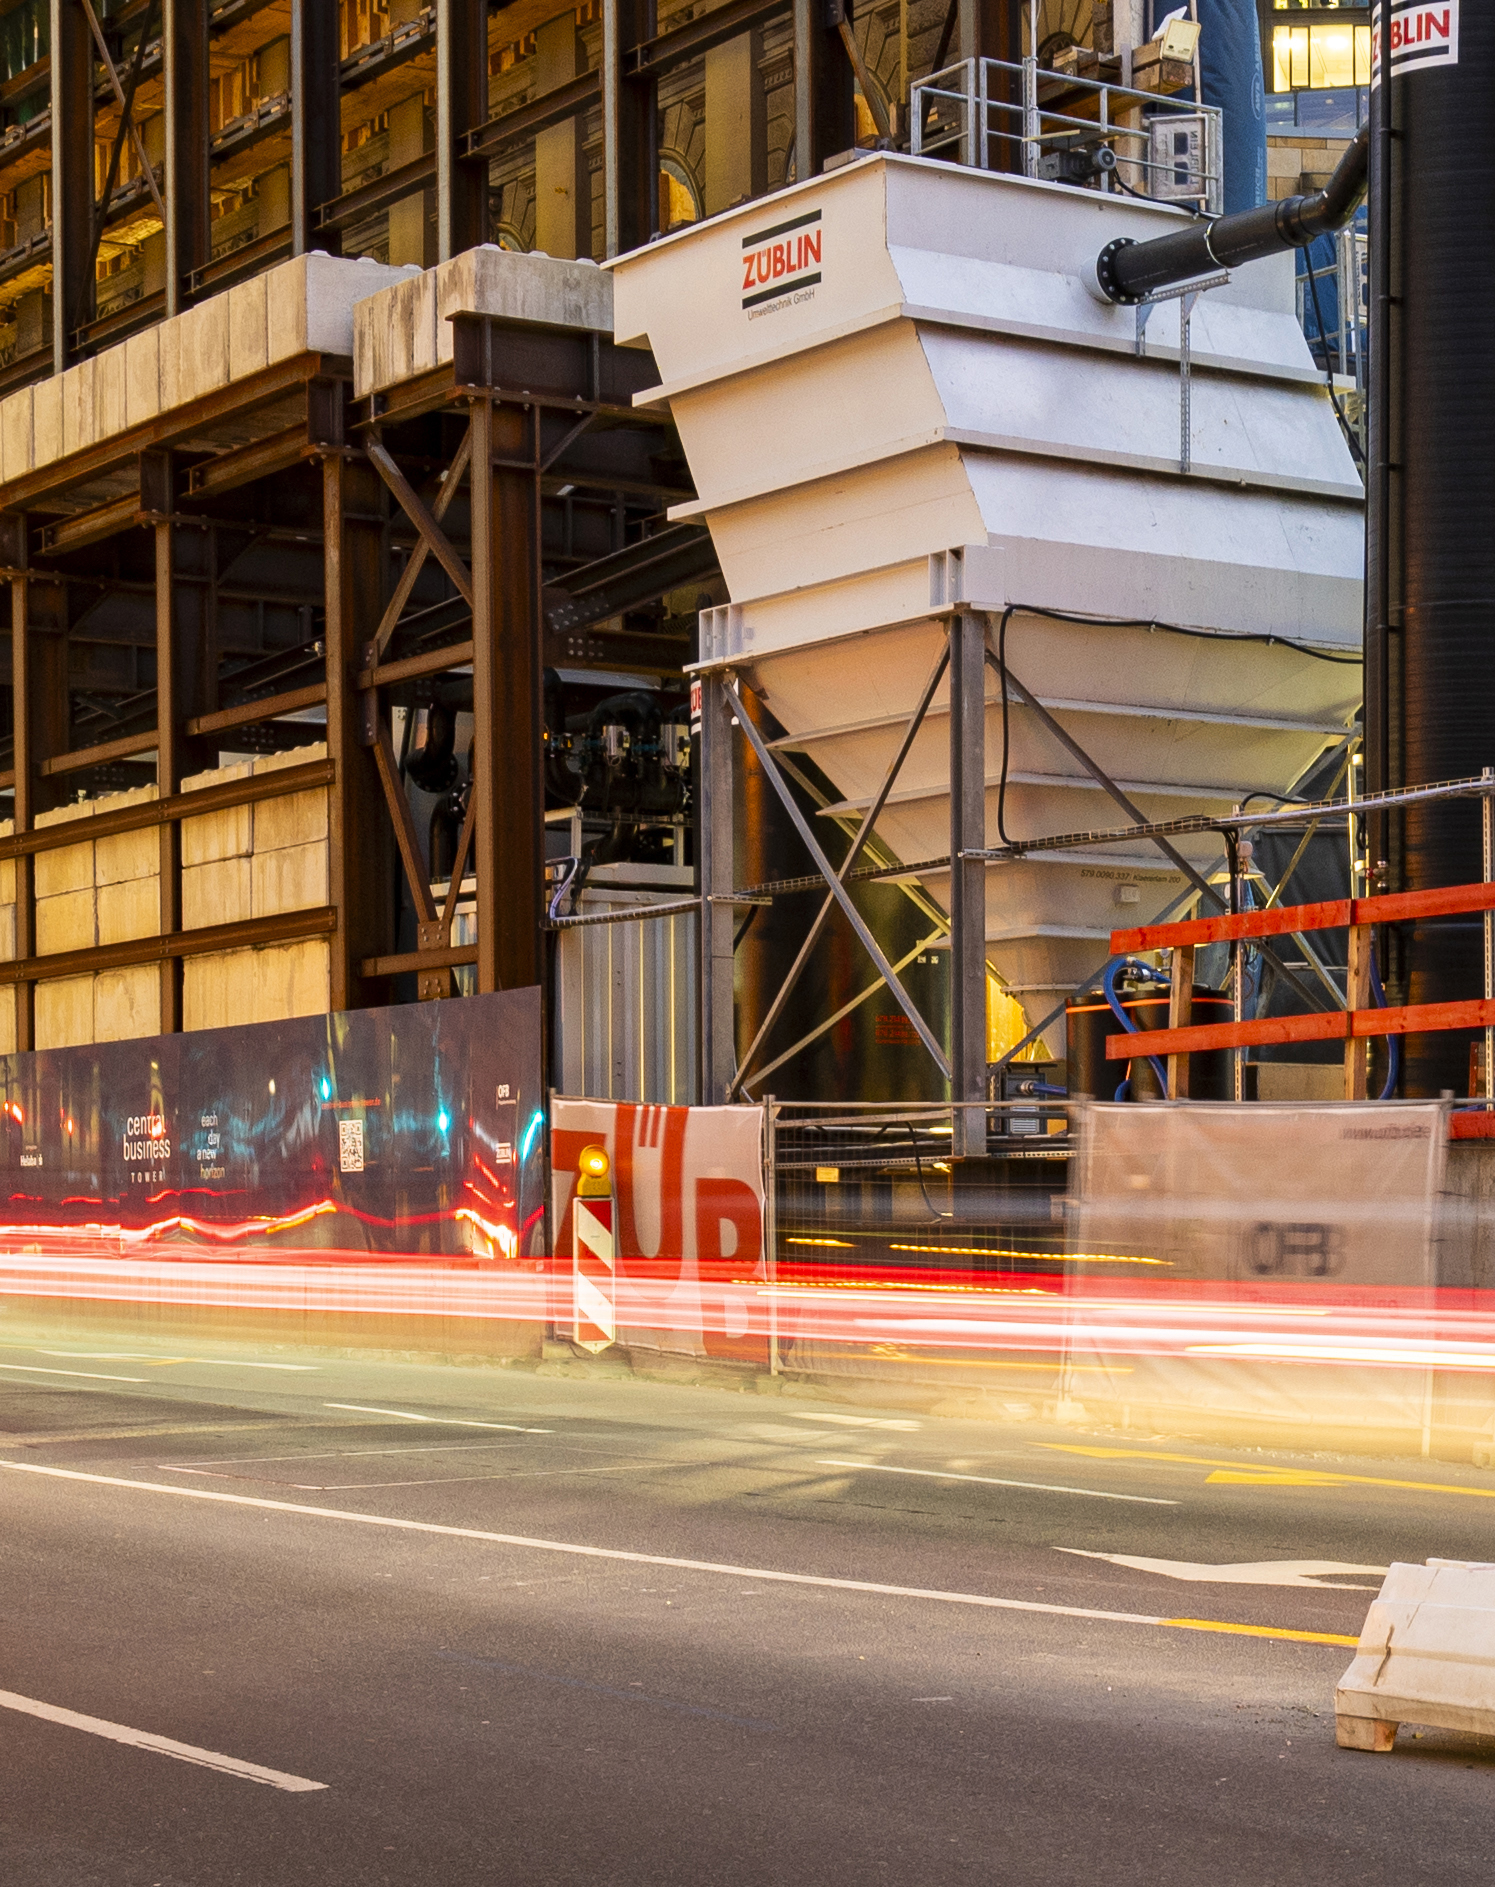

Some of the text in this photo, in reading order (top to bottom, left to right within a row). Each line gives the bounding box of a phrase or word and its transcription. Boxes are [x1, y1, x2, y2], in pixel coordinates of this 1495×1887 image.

[1372, 9, 1451, 64] ZBLIN
[742, 229, 822, 290] ZÜBLIN
[748, 288, 815, 321] Umwelttechnik GmbH
[123, 1133, 171, 1161] business
[131, 1170, 164, 1183] TOWER
